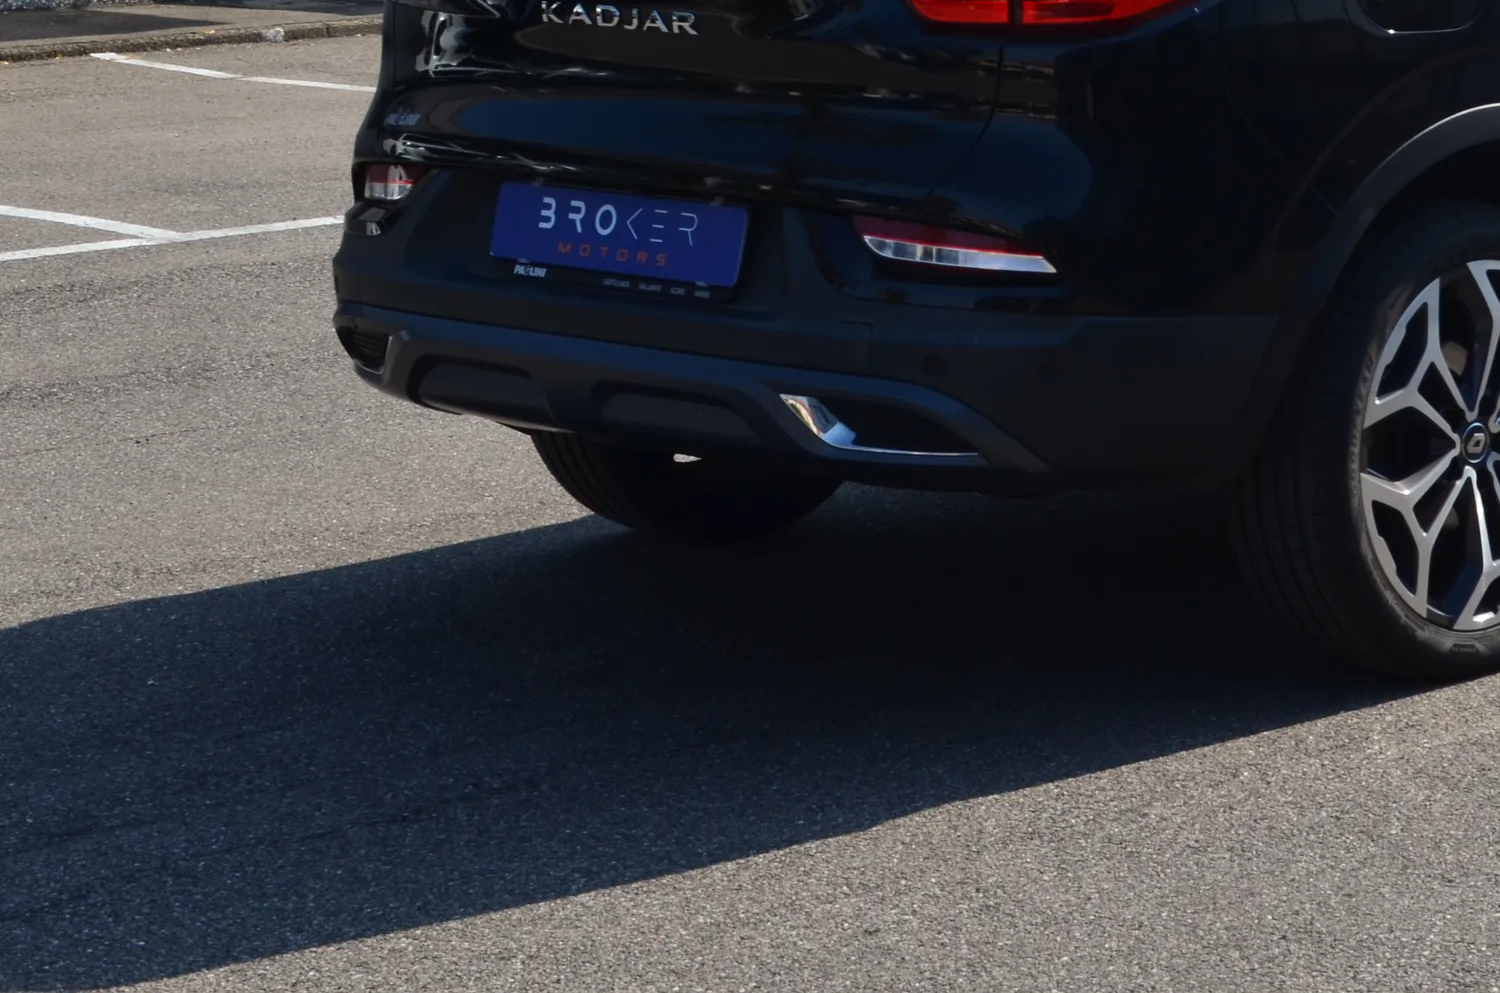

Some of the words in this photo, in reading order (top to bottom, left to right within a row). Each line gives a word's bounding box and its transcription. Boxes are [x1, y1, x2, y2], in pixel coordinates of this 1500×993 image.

[541, 0, 699, 36] KADJAR
[538, 196, 699, 246] BROKER
[557, 241, 668, 267] MOTORS
